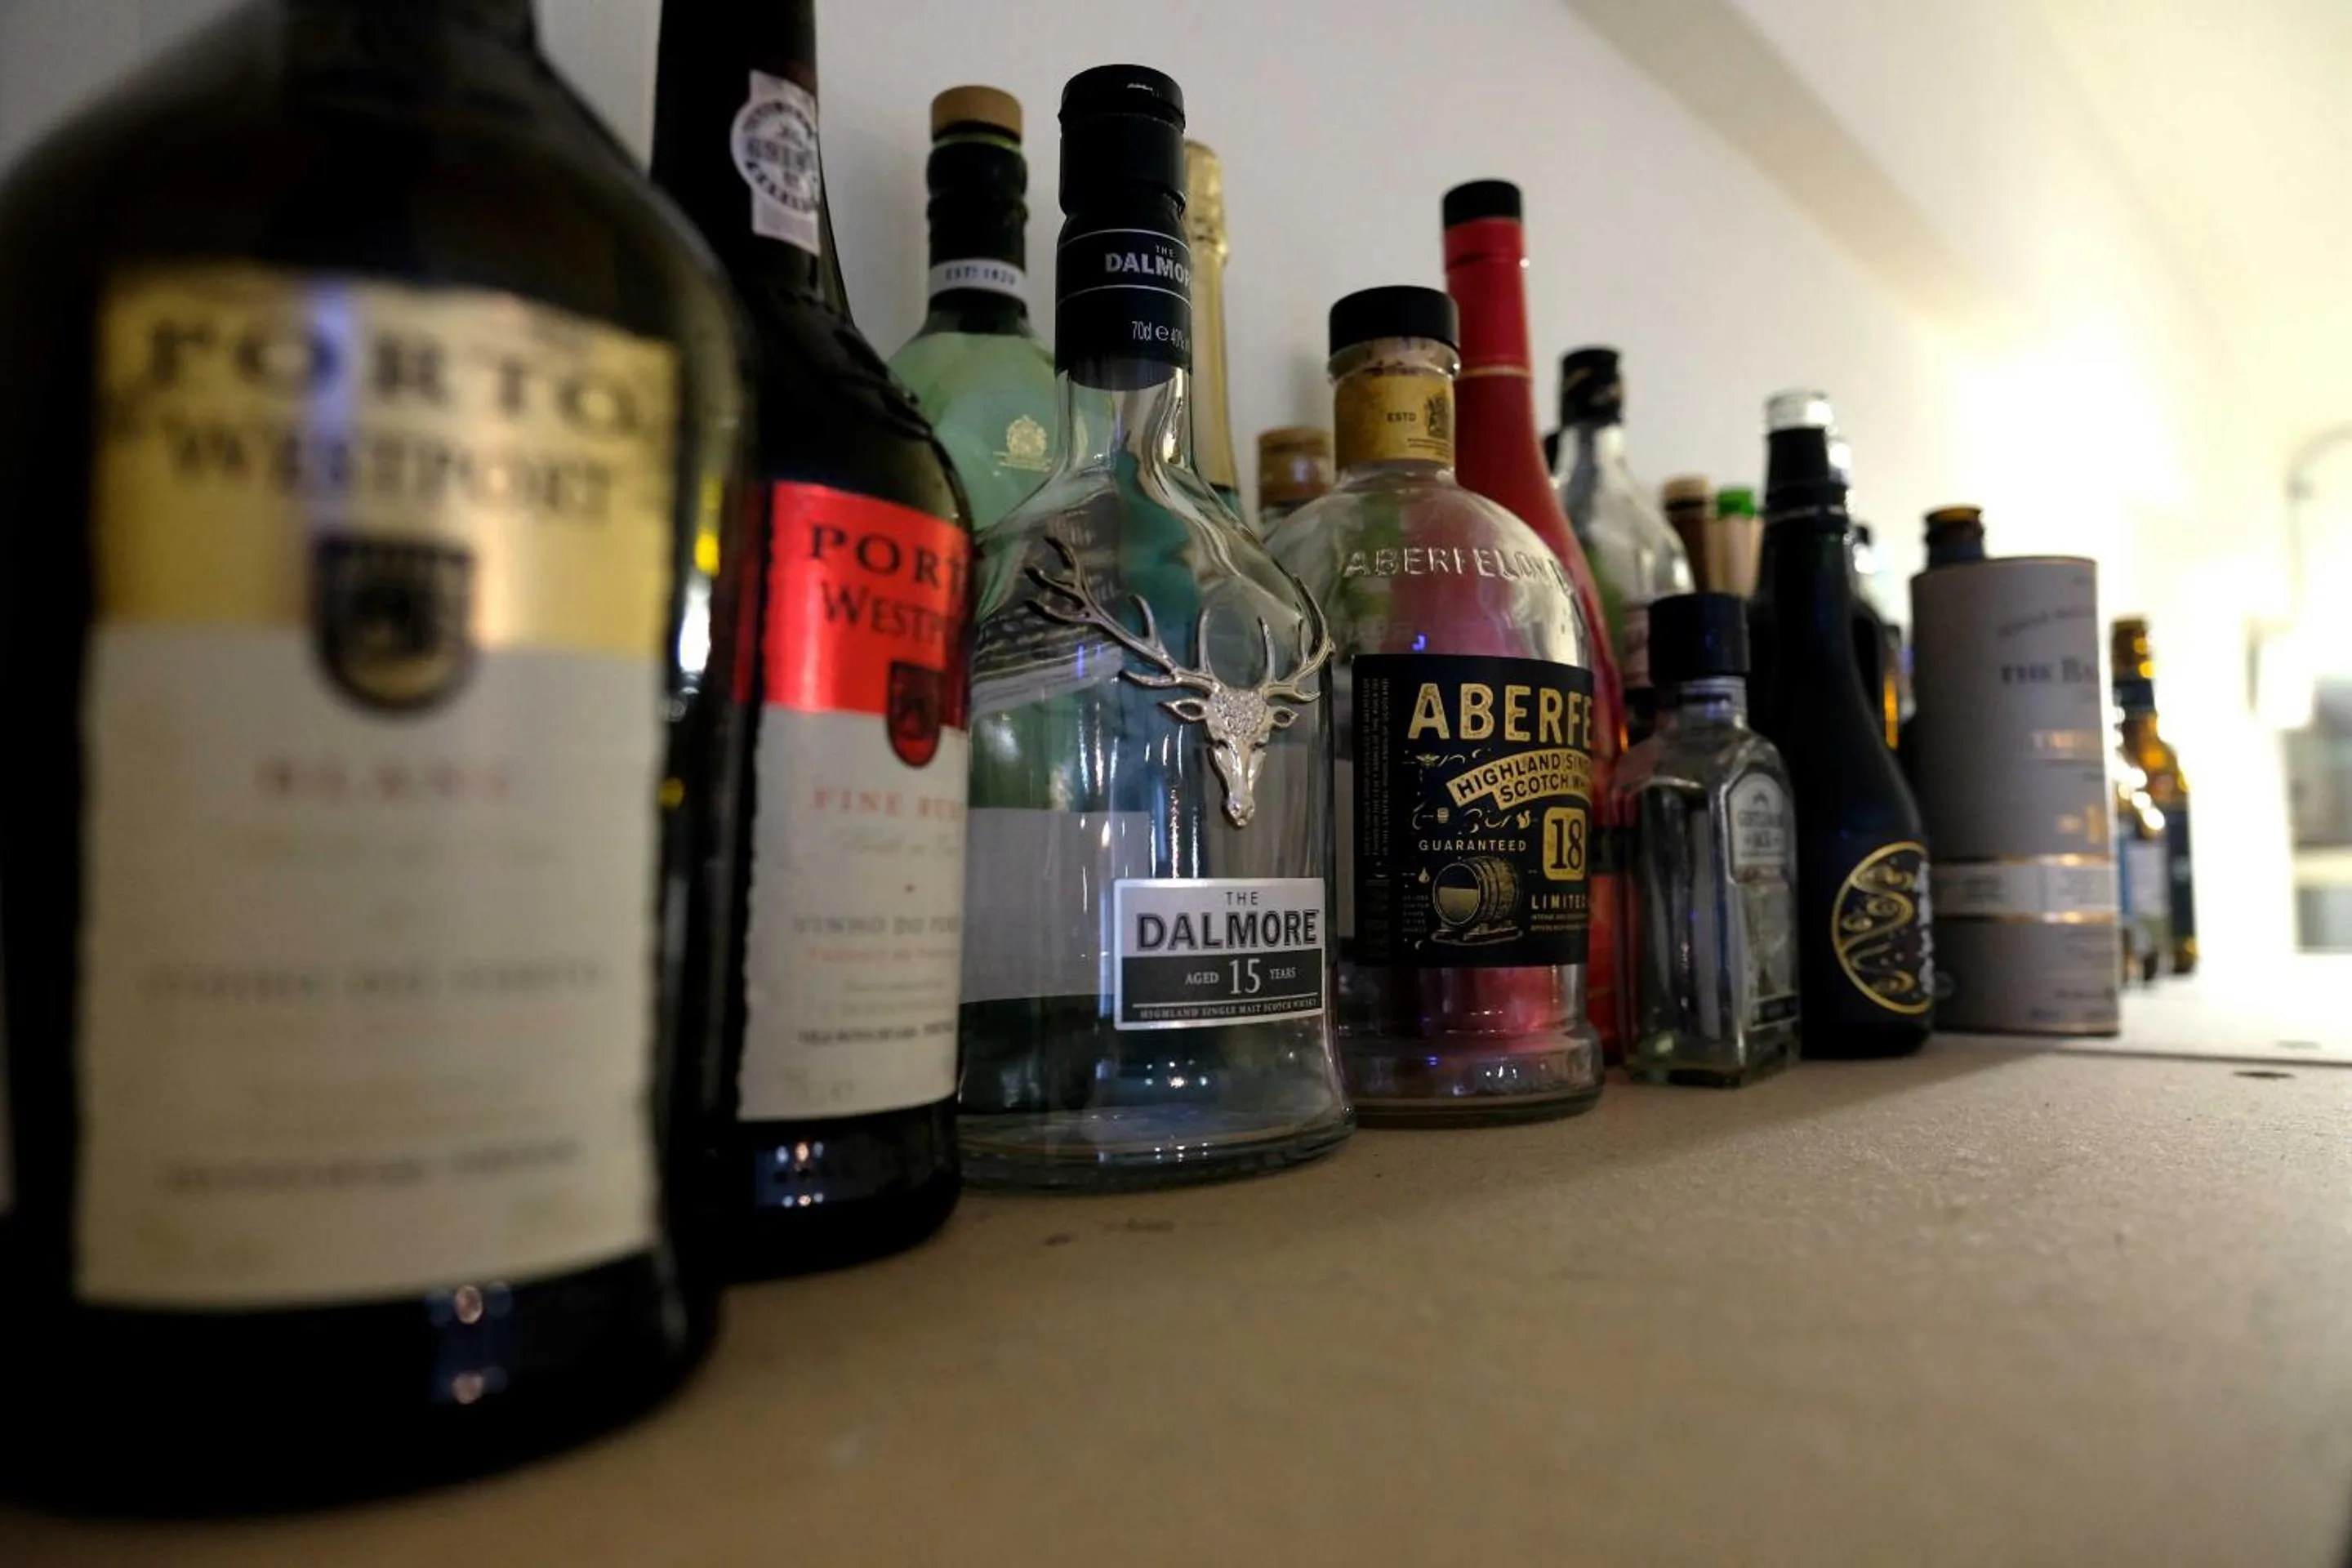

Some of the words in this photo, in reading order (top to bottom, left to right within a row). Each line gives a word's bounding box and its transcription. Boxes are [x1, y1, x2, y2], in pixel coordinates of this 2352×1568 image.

[1156, 244, 1176, 258] THE
[145, 317, 640, 434] PORTO
[1456, 753, 1561, 799] HIGHLAND
[1499, 773, 1568, 803] SCOTCH
[1419, 839, 1526, 852] GUARANTEED
[1551, 817, 1584, 871] 18
[1225, 891, 1258, 906] THE
[1136, 909, 1319, 951] DALMORE
[1185, 971, 1220, 986] AGED
[1228, 958, 1261, 995] 15
[1269, 966, 1297, 981] YEARS
[1140, 1008, 1199, 1019] HIGHLAND
[1201, 1005, 1237, 1017] SINGLE
[1240, 1004, 1262, 1014] MALT
